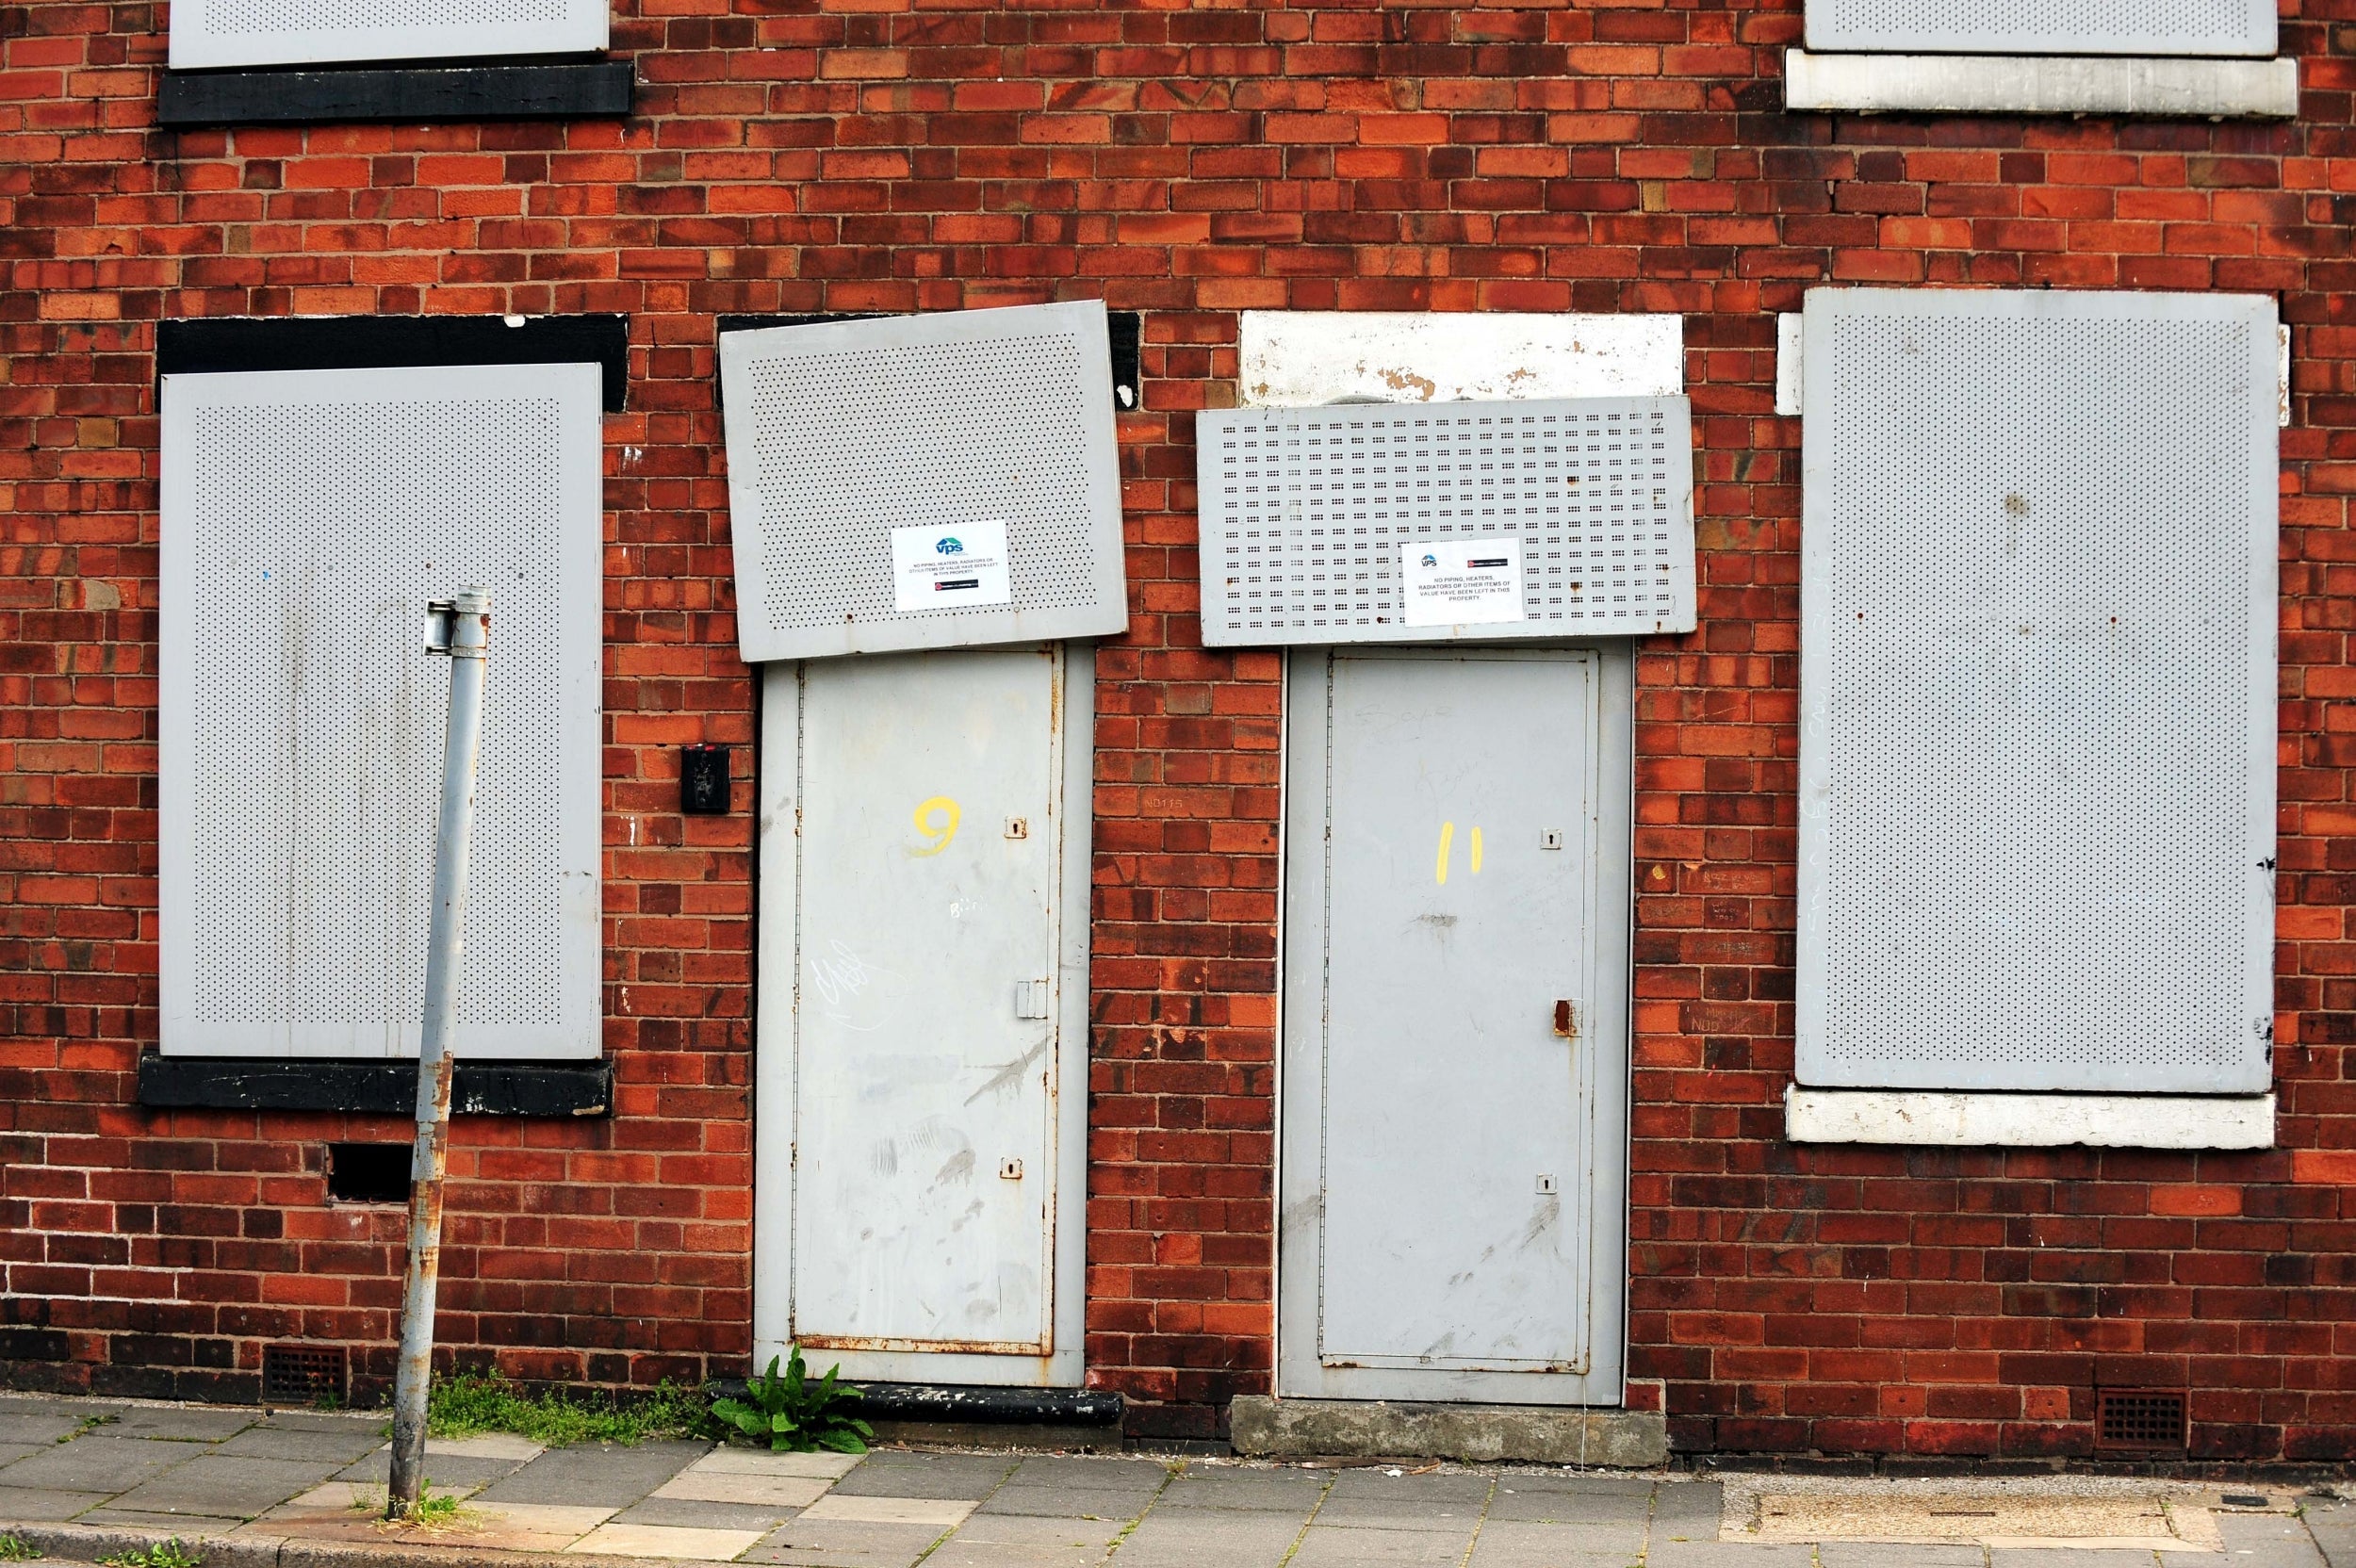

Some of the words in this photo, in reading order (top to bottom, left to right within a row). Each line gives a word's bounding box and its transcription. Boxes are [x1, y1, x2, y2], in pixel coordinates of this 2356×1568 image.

[936, 544, 964, 555] vps
[901, 794, 962, 861] 9
[1435, 820, 1483, 887] 11
